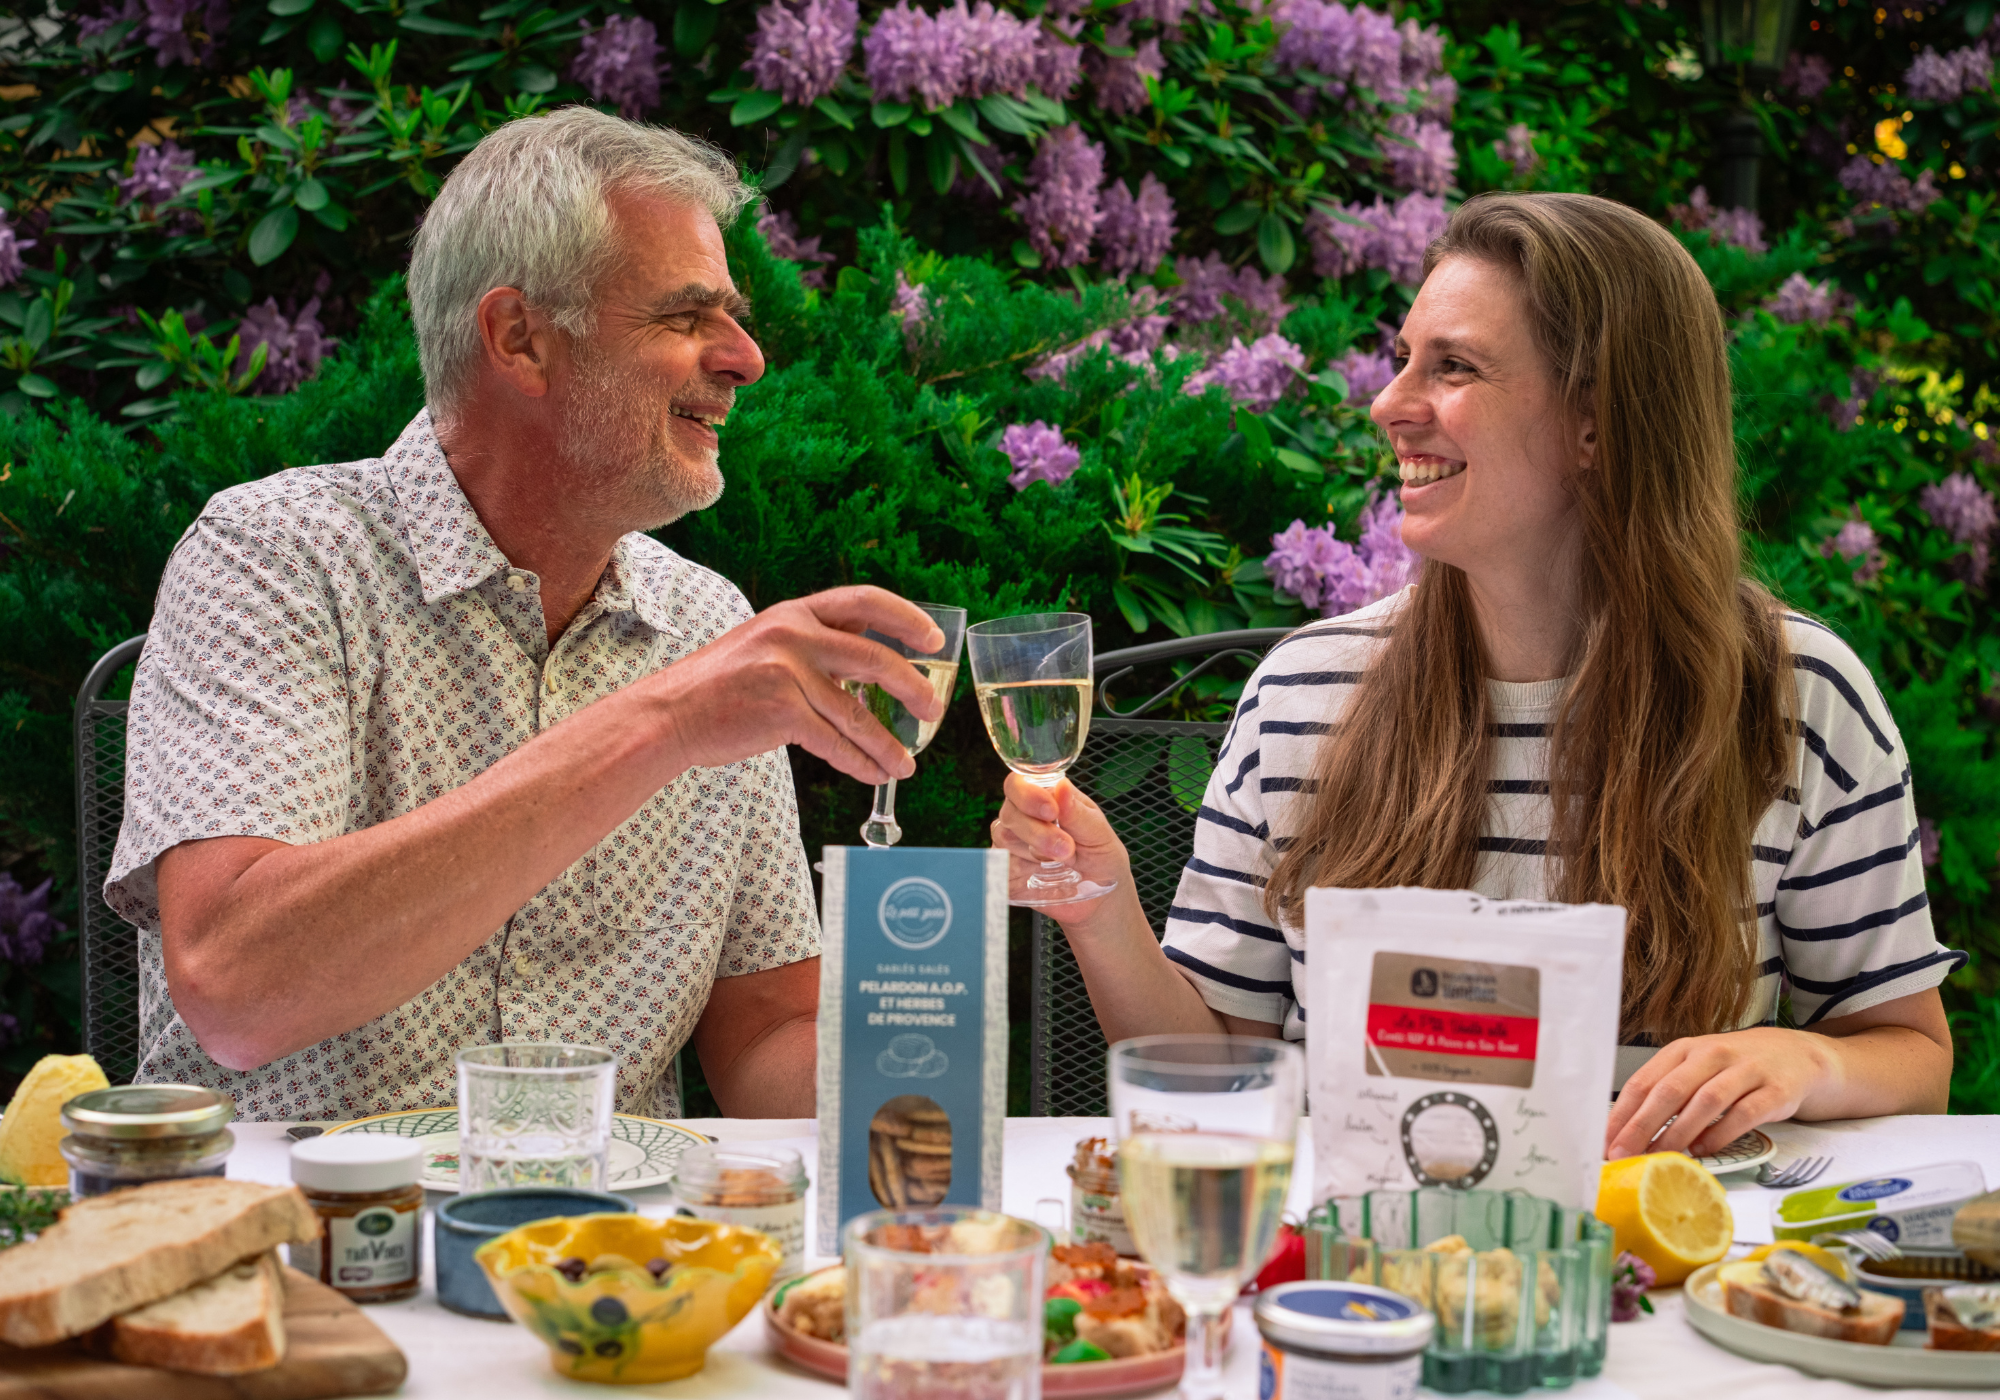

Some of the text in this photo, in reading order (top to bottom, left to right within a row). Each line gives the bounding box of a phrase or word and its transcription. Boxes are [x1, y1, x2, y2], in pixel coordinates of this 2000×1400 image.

[918, 964, 951, 975] SALÉS
[859, 980, 969, 996] PELARDON A.O.P.
[879, 996, 945, 1010] ET HERBES
[867, 1012, 957, 1027] DE PROVENCE
